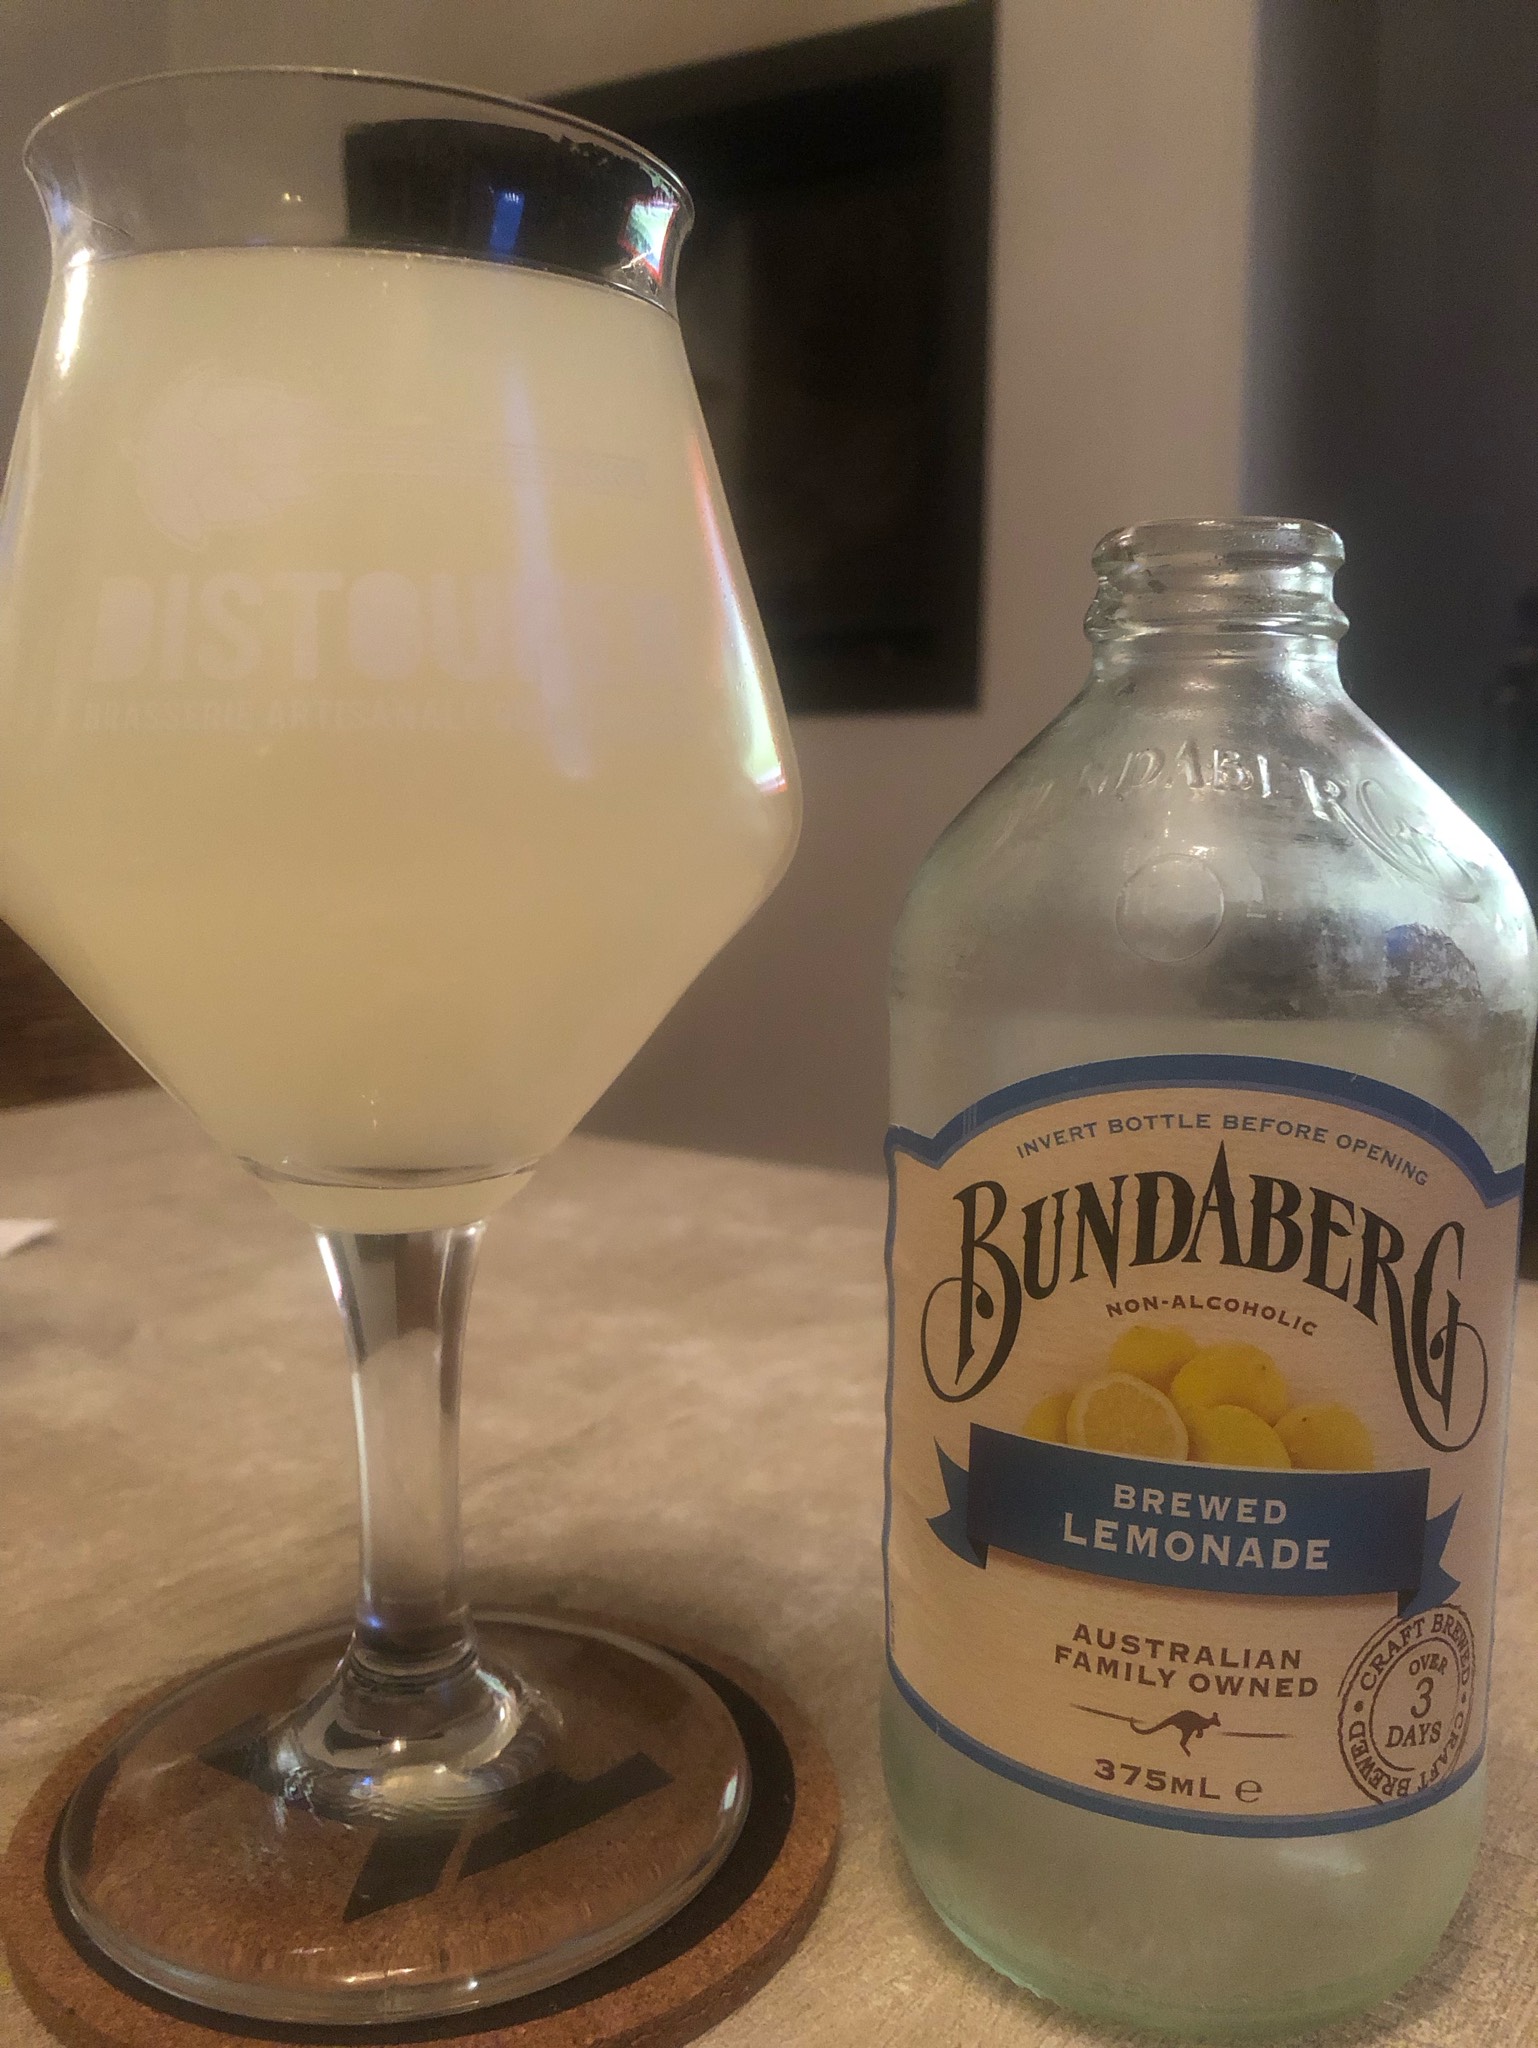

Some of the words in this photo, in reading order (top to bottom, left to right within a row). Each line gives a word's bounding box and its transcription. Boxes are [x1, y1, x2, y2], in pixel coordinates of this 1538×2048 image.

[1016, 1121, 1098, 1159] INVERT
[1107, 1113, 1211, 1135] BOTTLE
[1222, 1114, 1329, 1144] BEFORE
[1336, 1133, 1428, 1187] OPENING
[920, 1139, 1489, 1453] BUNDABERG
[1105, 1294, 1318, 1337] NON-ALCOHOLIC
[1113, 1483, 1288, 1525] BREWED
[1062, 1512, 1331, 1571] LEMONADE
[1053, 1644, 1177, 1689] FAMILY
[1188, 1672, 1319, 1698] OWNED
[1072, 1622, 1301, 1670] AUSTRALIAN
[1360, 1616, 1426, 1691] CRAFT
[1430, 1613, 1472, 1686] BREWED
[1408, 1653, 1449, 1677] OVER
[1410, 1676, 1434, 1719] 3
[1349, 1720, 1412, 1798] BREWED
[1384, 1720, 1443, 1748] DAYS
[1417, 1711, 1465, 1790] CRAFT
